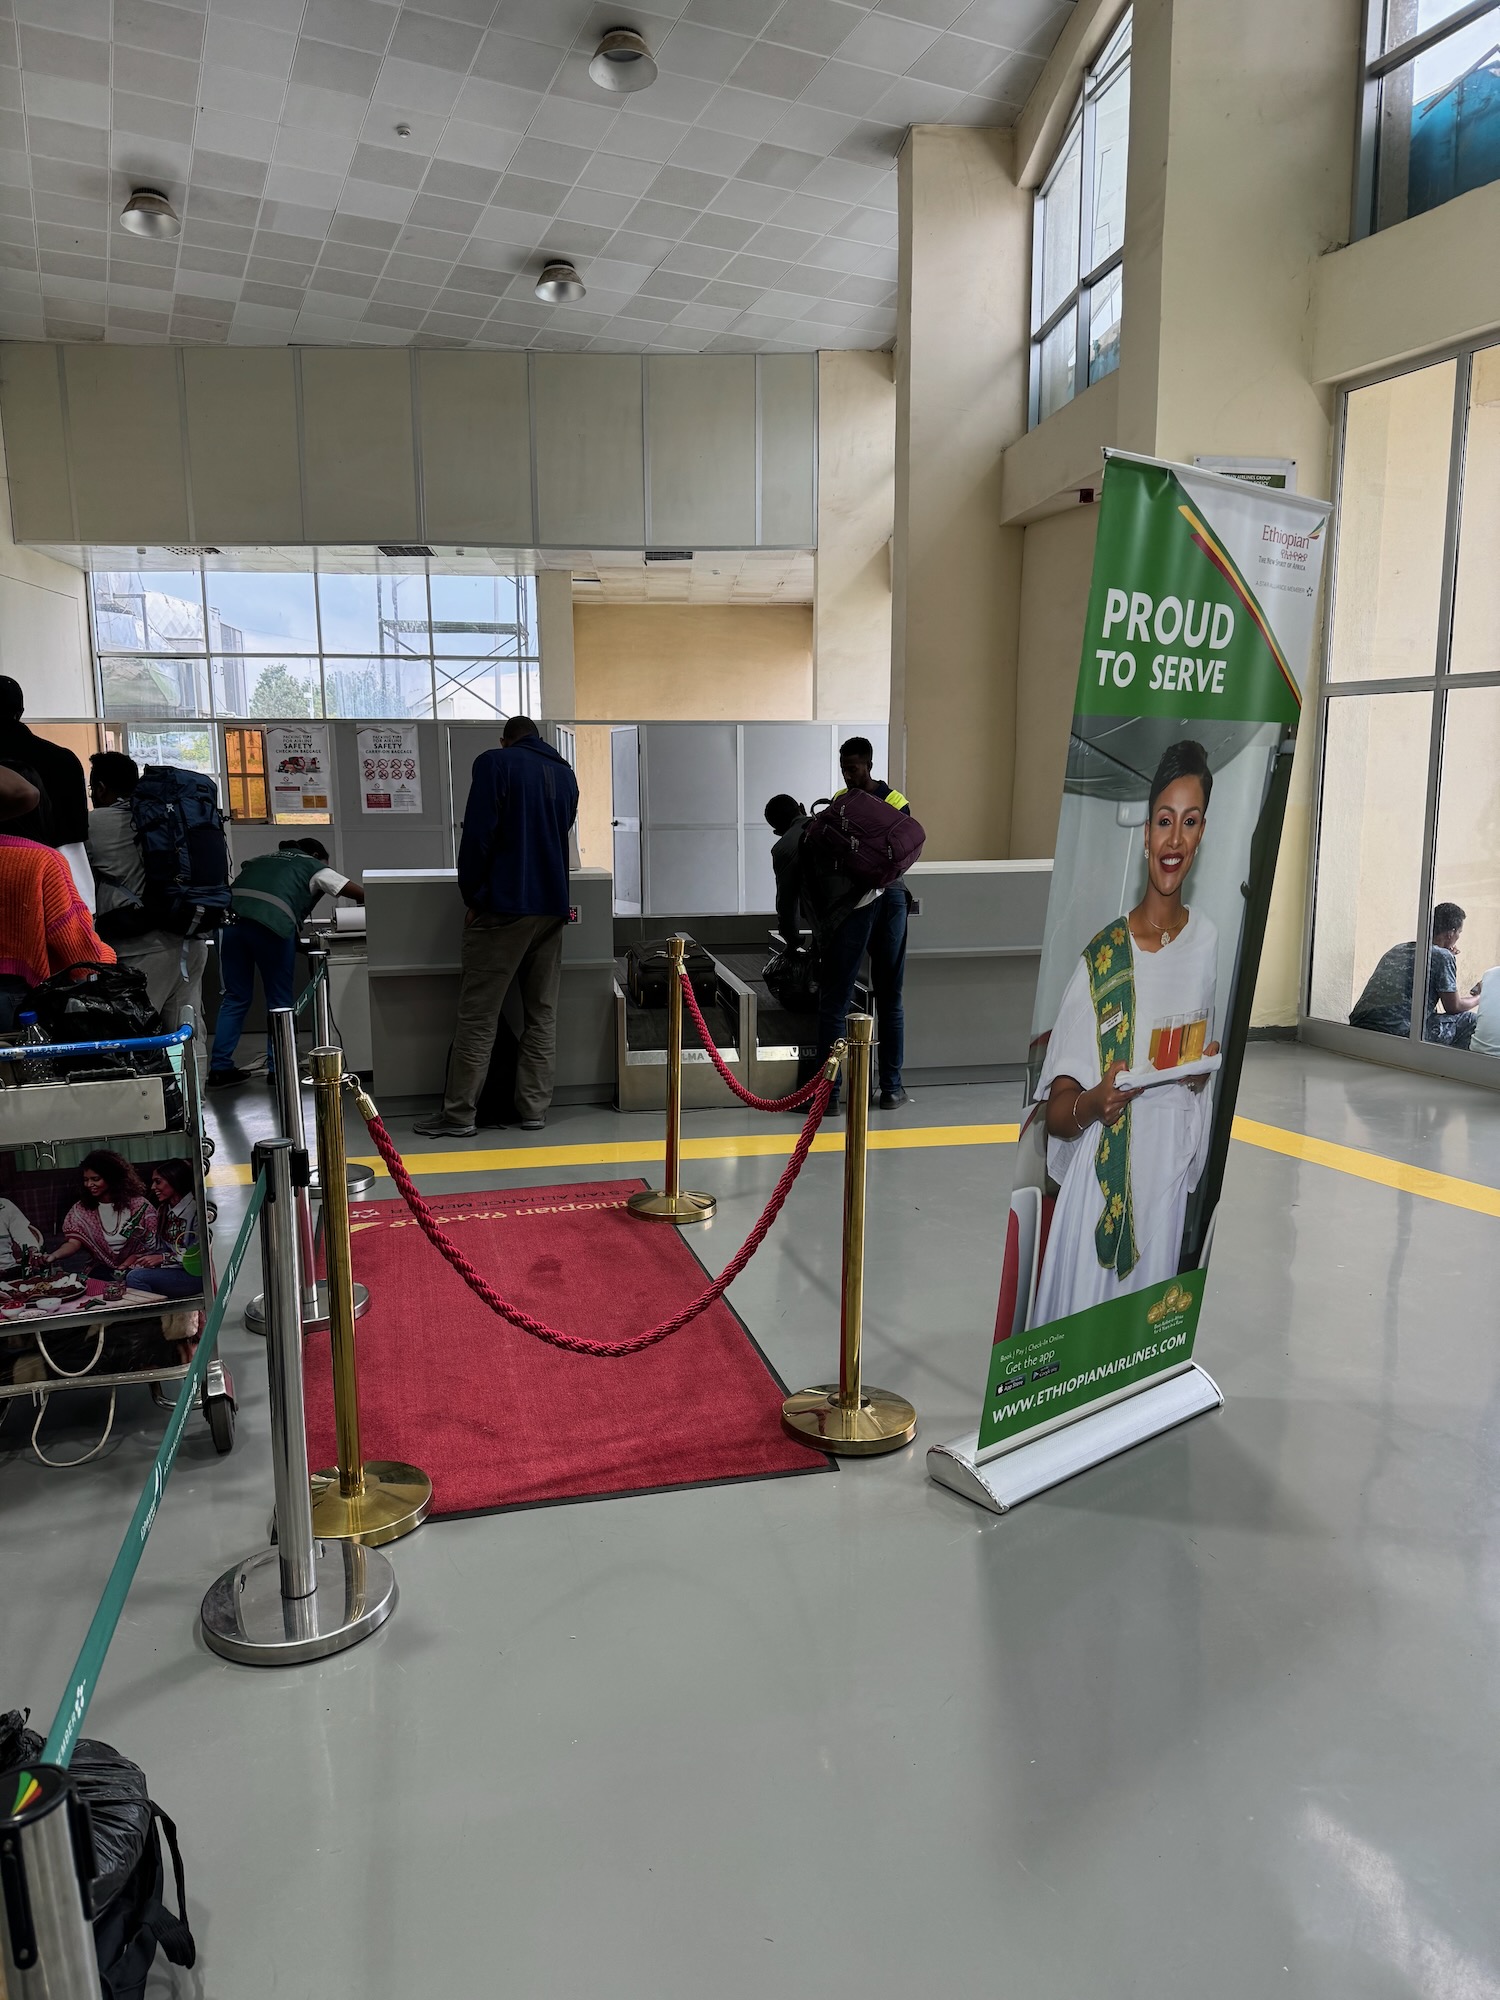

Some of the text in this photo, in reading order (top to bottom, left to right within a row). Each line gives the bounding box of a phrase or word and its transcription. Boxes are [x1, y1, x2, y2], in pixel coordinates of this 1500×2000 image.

[1262, 524, 1310, 549] Ethiopian
[1101, 587, 1235, 650] PROUD
[1096, 649, 1227, 694] TO SERVE
[682, 1052, 705, 1061] LMA
[479, 1194, 568, 1207] ALLIANCE
[574, 1190, 620, 1199] STAR
[391, 1202, 472, 1214] MEMER
[515, 1200, 629, 1216] thiopian
[1048, 1333, 1065, 1343] Online
[1005, 1350, 1055, 1375] Get the app
[992, 1332, 1187, 1424] WWW.ETHIOPIANAIRLINES.COM
[55, 1711, 77, 1766] EMBER
